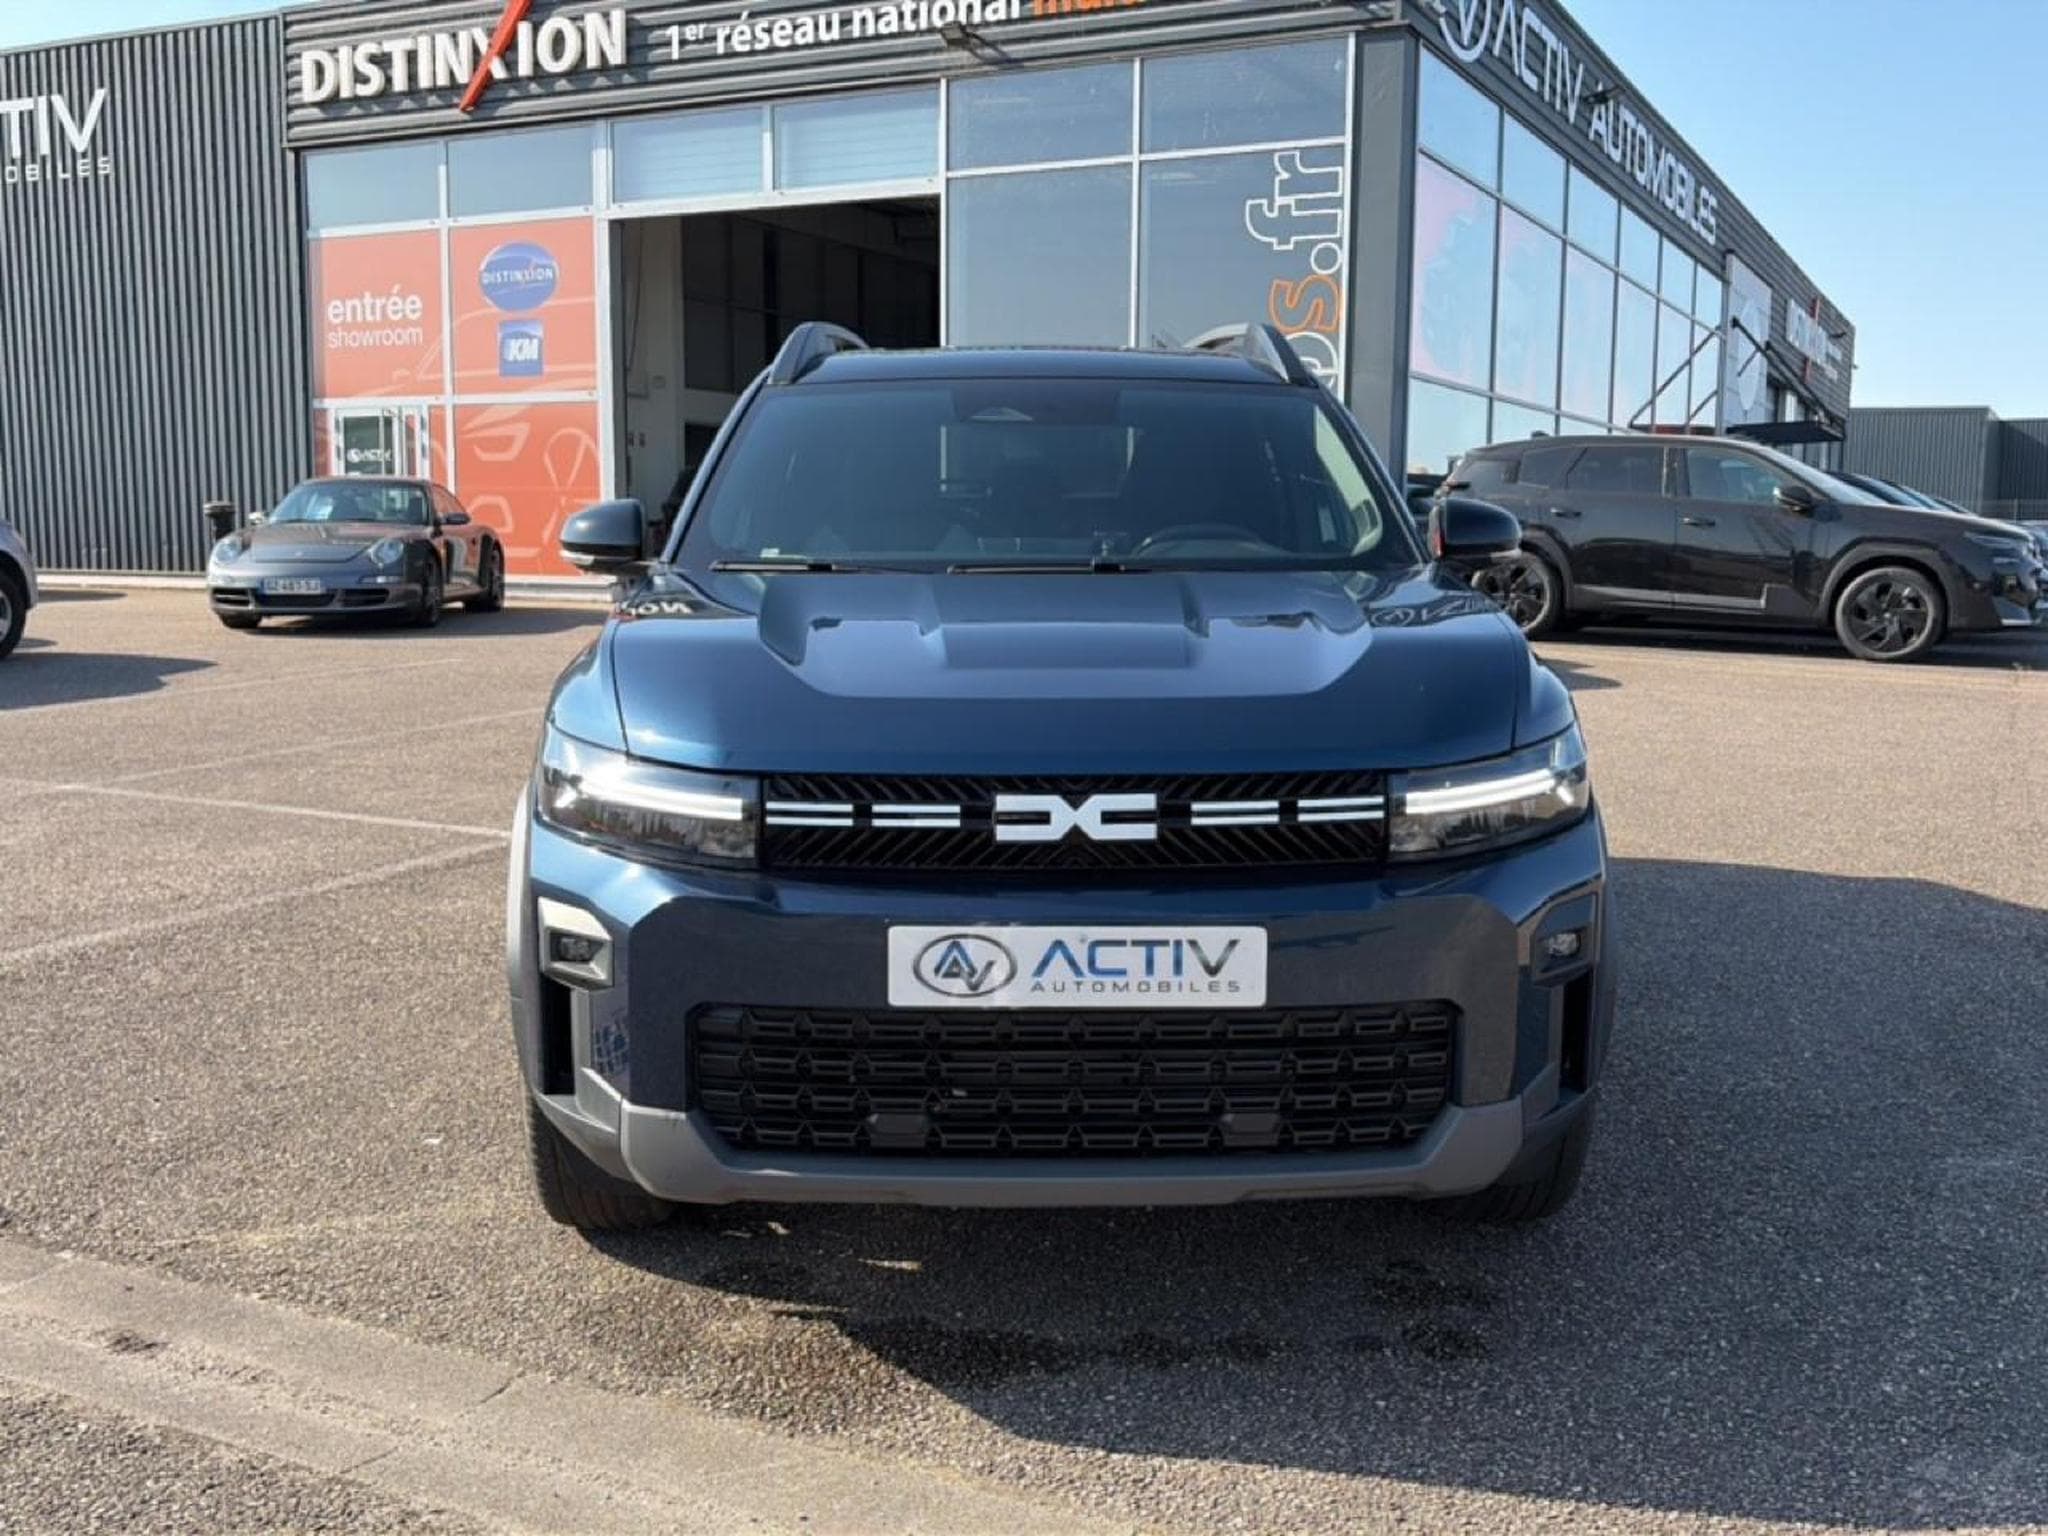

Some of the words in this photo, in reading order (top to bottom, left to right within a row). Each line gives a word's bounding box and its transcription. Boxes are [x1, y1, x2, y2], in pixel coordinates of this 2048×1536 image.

[665, 24, 706, 60] 1er
[716, 10, 840, 54] réseau
[300, 0, 627, 112] DISTINXION
[0, 89, 105, 159] TIV
[1493, 0, 1584, 124] ACTIV
[1589, 81, 1717, 245] AUTOMOBILES
[5, 157, 110, 183] OBILES
[482, 267, 554, 284] DISTINXION
[327, 284, 423, 323] entrée
[327, 327, 423, 348] showroom
[504, 338, 539, 361] KM
[1031, 938, 1241, 978] ACTIV
[1030, 980, 1241, 993] AUTOMOBILES
